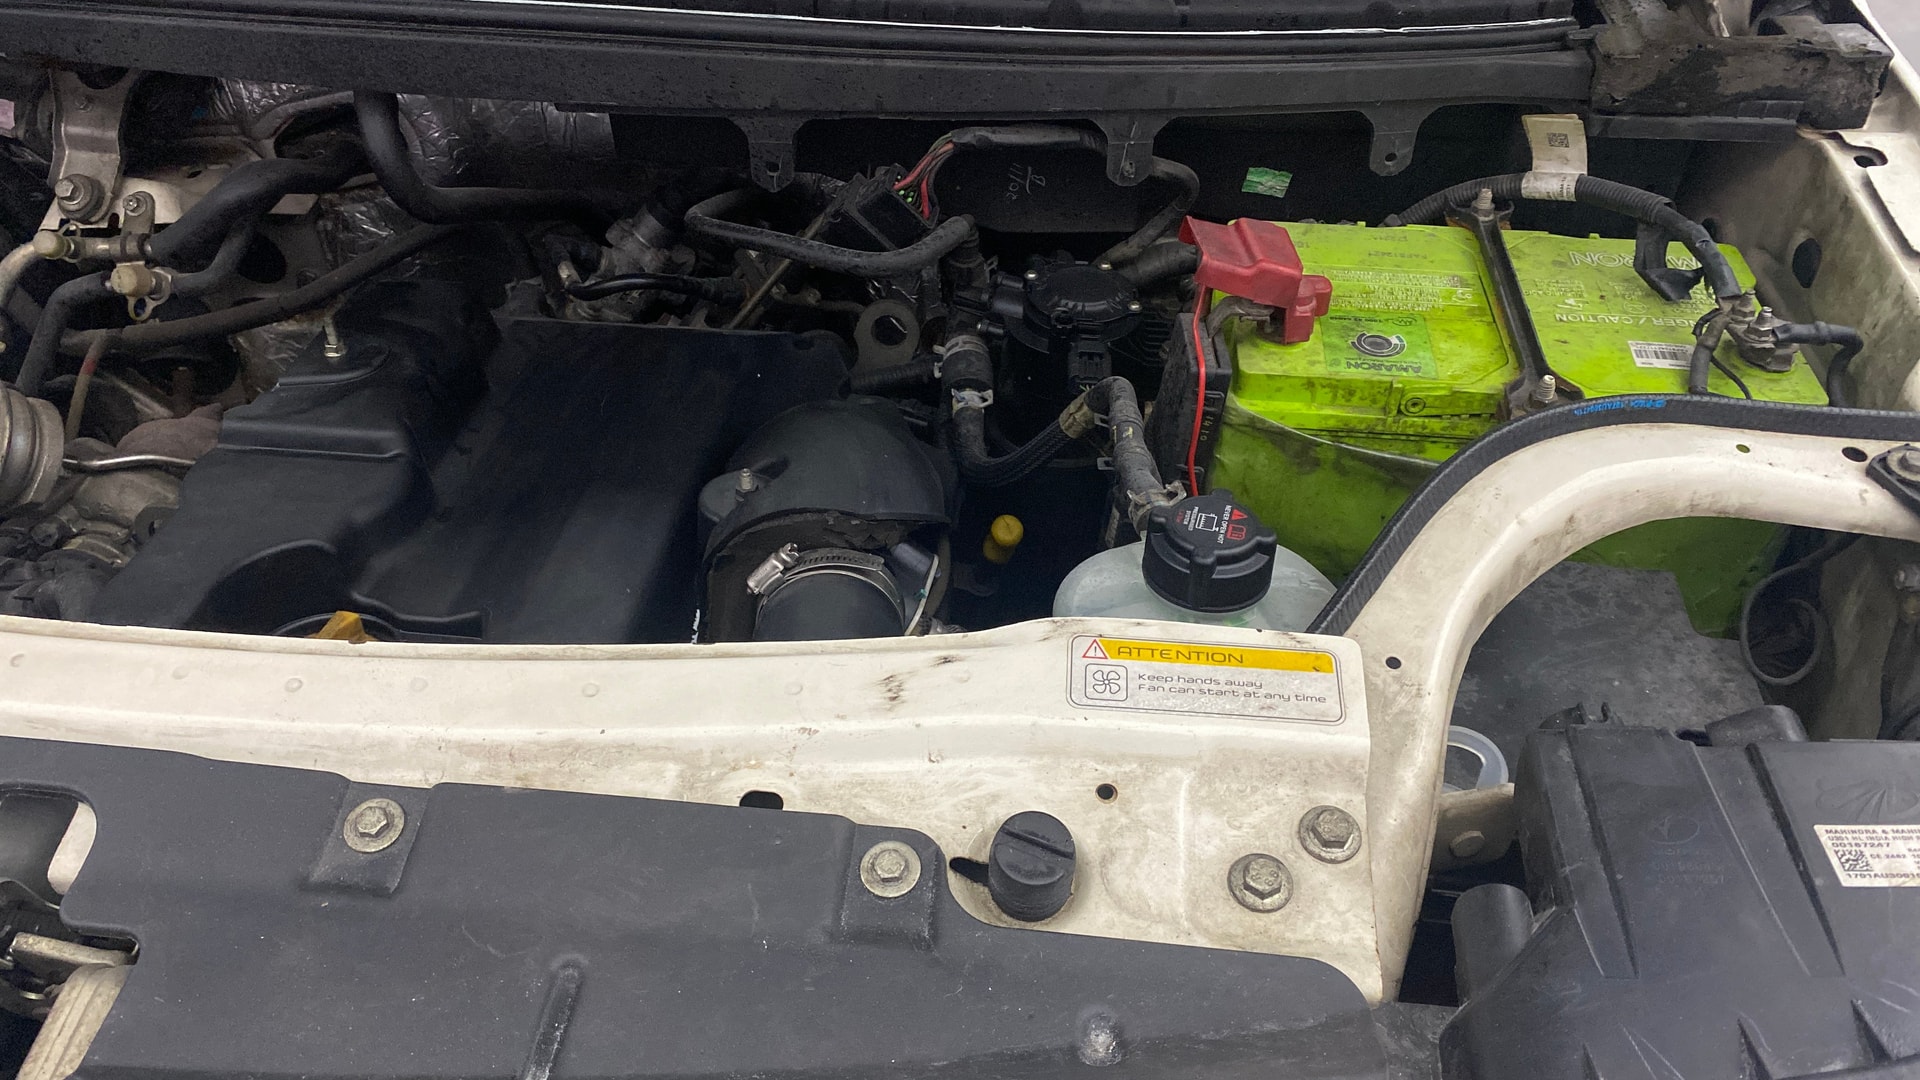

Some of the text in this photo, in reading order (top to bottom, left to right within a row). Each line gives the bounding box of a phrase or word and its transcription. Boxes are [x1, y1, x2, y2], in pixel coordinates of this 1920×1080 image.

[1555, 313, 1632, 325] CAUTION
[1346, 361, 1422, 374] AMARON
[1216, 505, 1232, 544] NEVER OPEN HOT
[1117, 646, 1243, 664] ATTENTION
[1138, 674, 1263, 689] Keep hands away
[1138, 684, 1327, 704] Fan can start at any time
